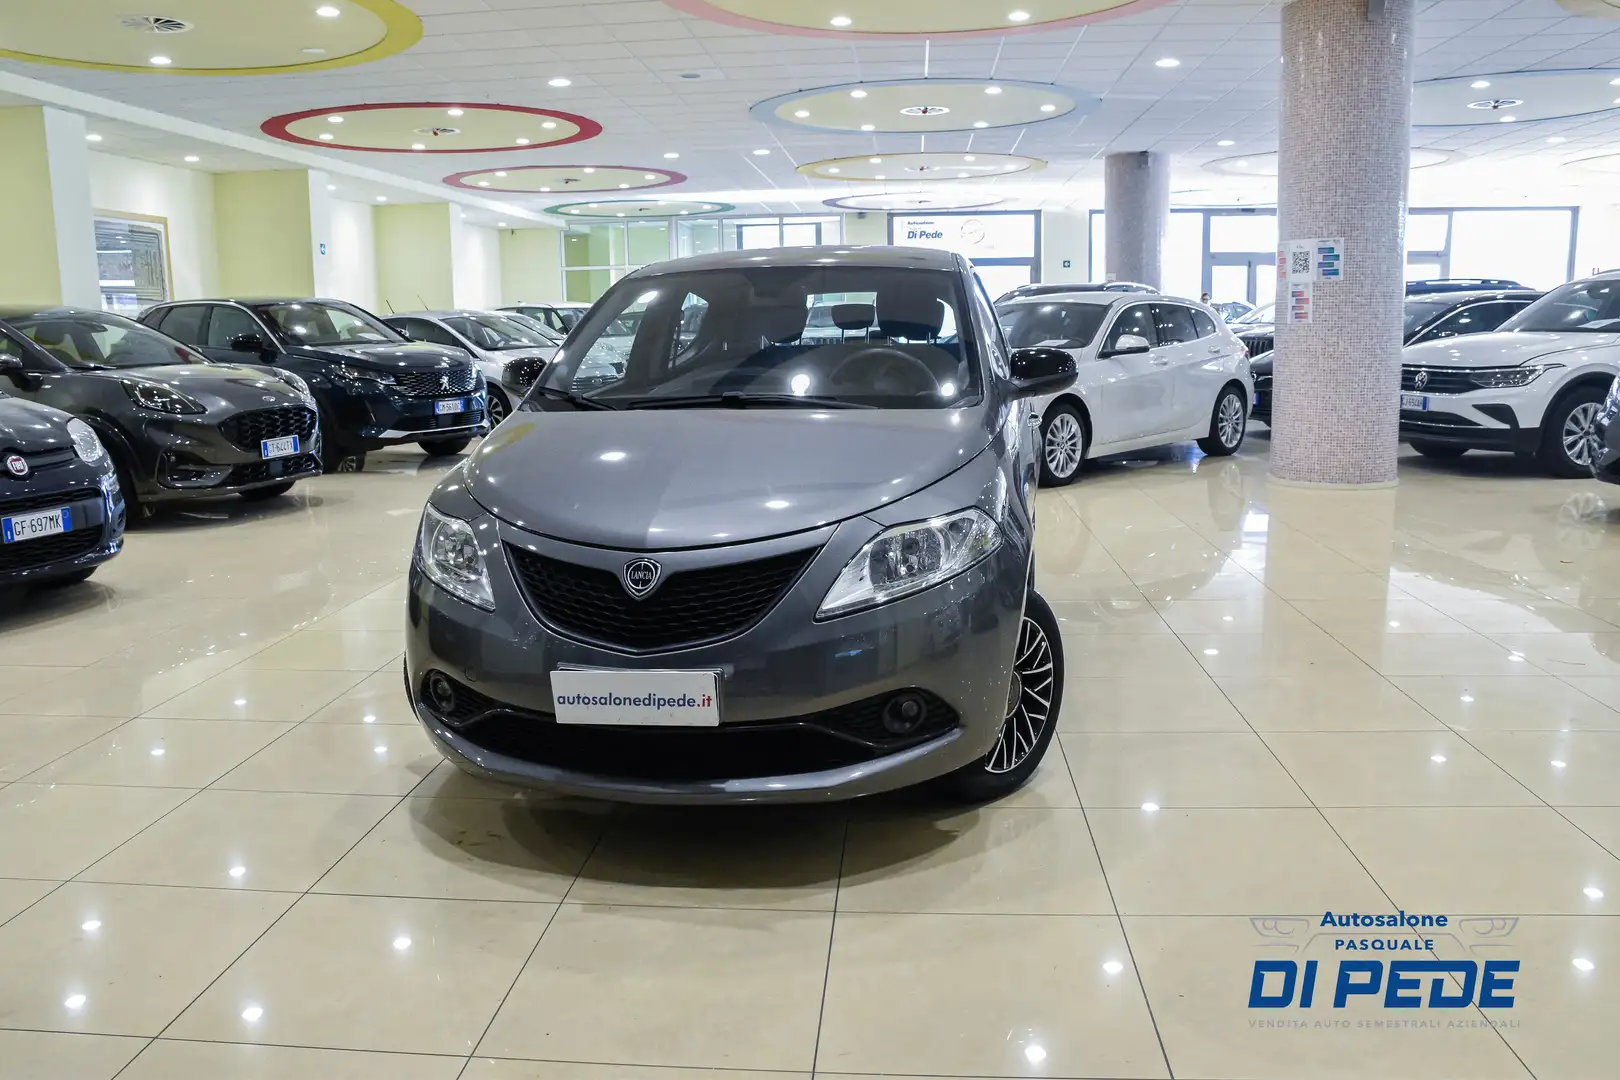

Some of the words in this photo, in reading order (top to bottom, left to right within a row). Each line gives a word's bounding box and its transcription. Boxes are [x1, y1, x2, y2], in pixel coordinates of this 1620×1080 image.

[907, 230, 918, 239] Di
[919, 230, 943, 239] Pede
[631, 570, 652, 580] LANCIA
[557, 692, 713, 710] autosalonedipede.it
